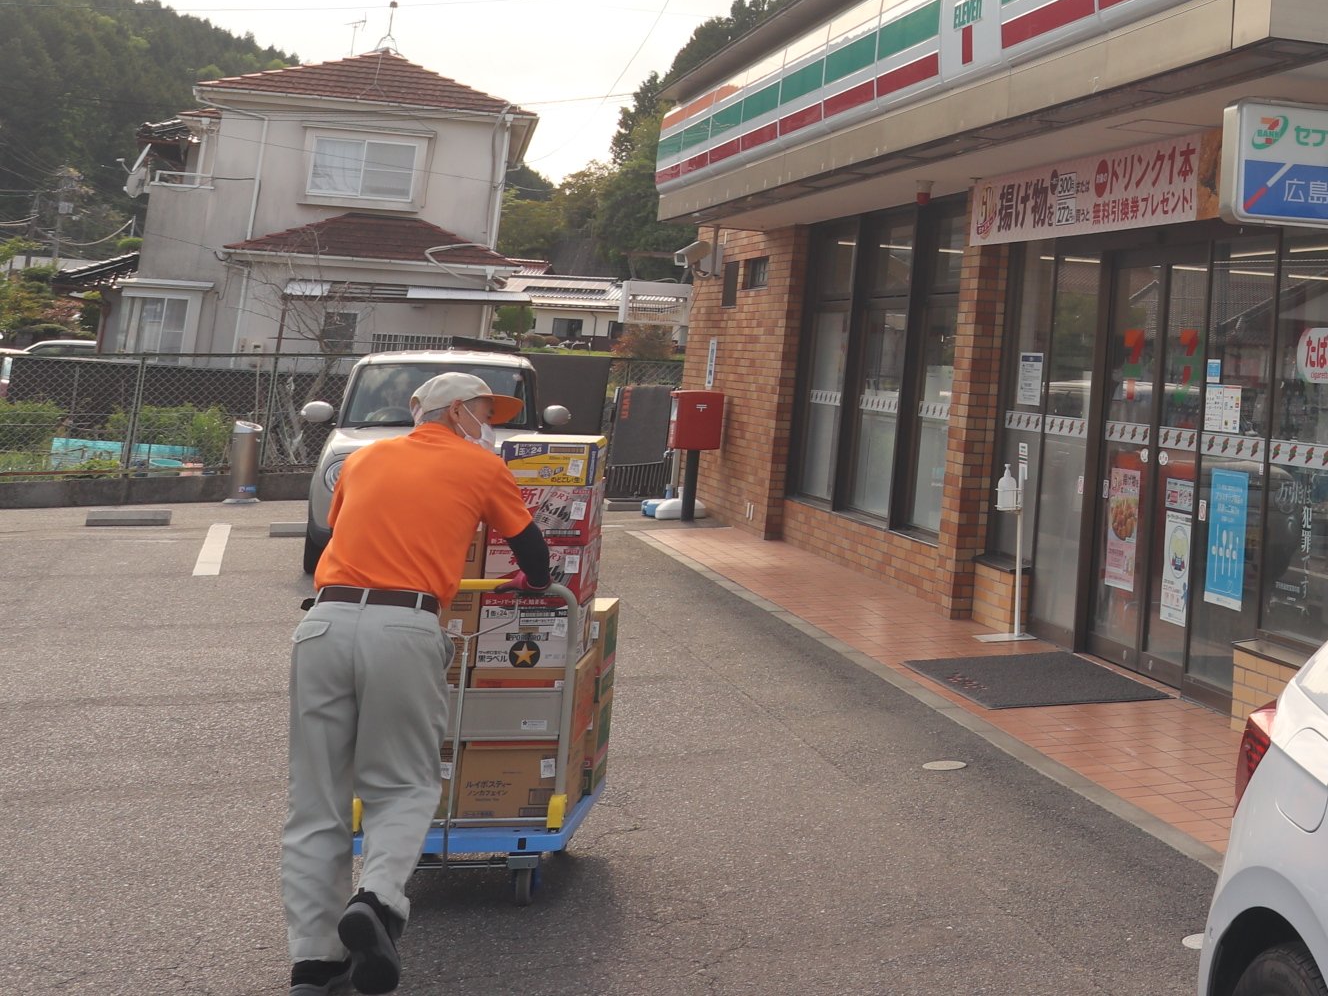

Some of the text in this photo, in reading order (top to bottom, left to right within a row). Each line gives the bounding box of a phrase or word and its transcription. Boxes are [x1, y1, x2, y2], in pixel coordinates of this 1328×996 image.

[1257, 129, 1281, 138] BANK
[1109, 143, 1196, 194] ドリンク1本
[997, 179, 1054, 232] 揚げ物を
[551, 491, 572, 502] DRY
[478, 655, 508, 663] 黒ラベル
[465, 780, 512, 789] ルイボスティー
